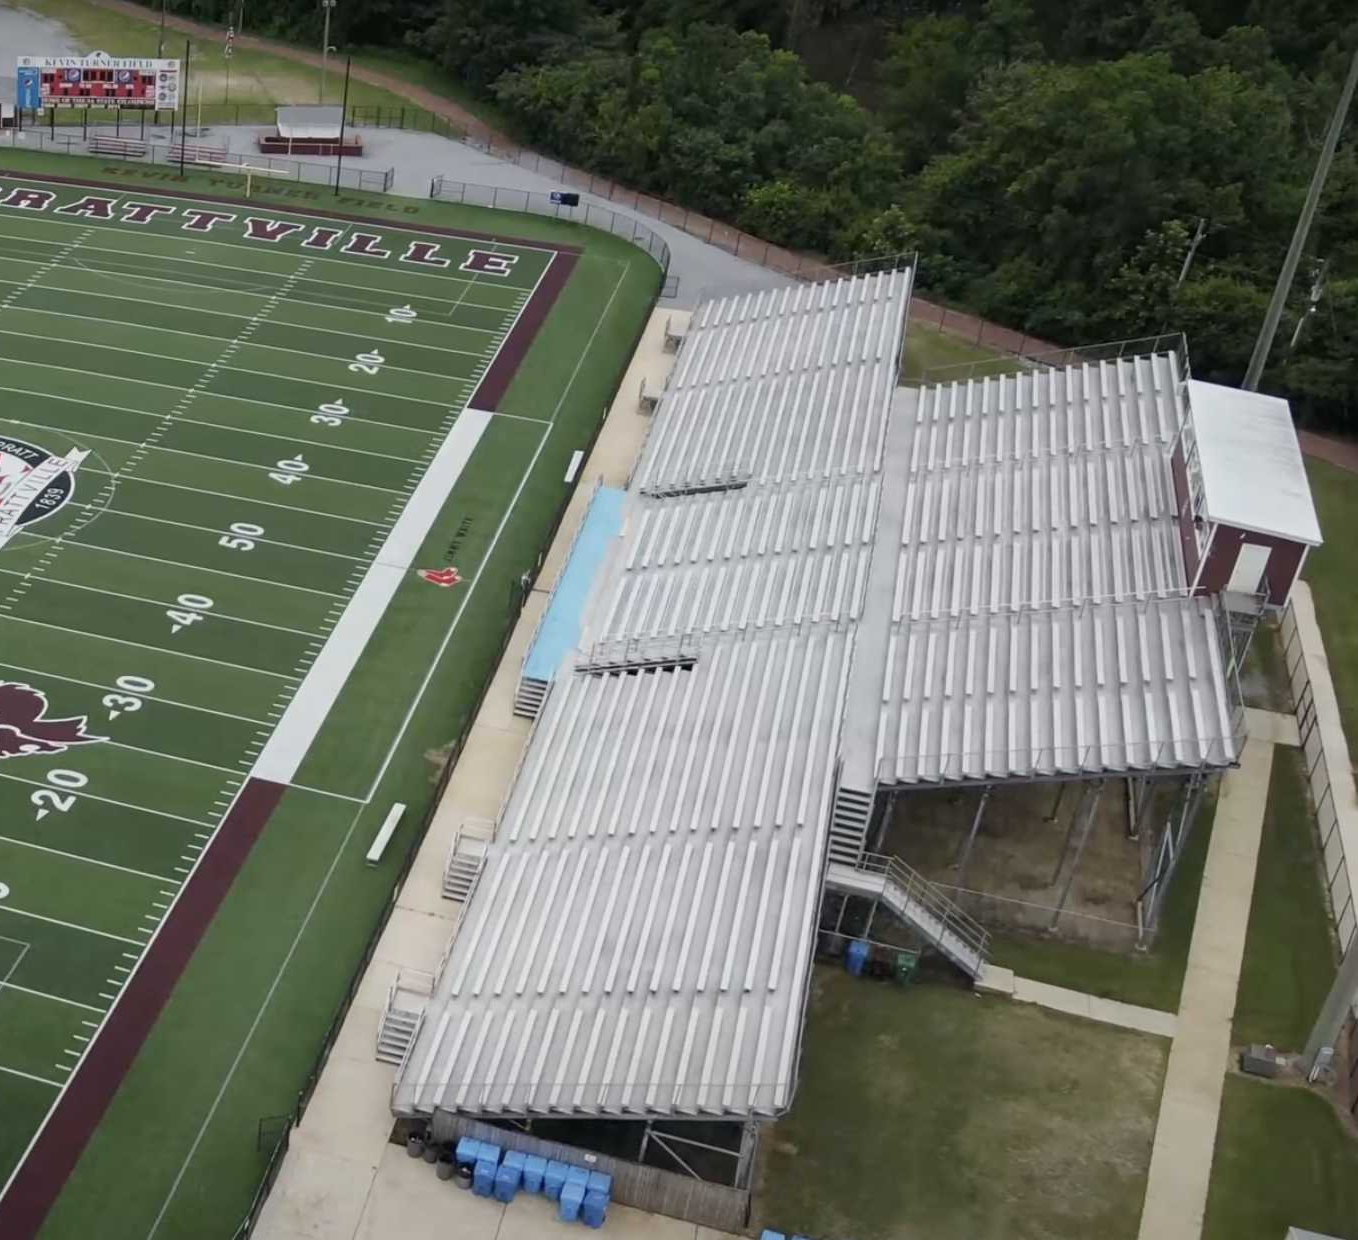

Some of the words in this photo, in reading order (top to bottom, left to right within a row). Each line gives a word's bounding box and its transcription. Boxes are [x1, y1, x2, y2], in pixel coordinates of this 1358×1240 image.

[45, 58, 76, 66] KEVIN
[80, 59, 120, 67] TURNER
[123, 59, 153, 68] FIELD
[99, 166, 191, 183] KEVIN
[208, 178, 321, 200] TURNER
[336, 196, 421, 214] FIELD
[384, 308, 418, 324] 10
[348, 353, 385, 375] 20
[310, 404, 350, 427] 30
[268, 459, 310, 485] 40
[35, 487, 65, 510] 1839
[218, 522, 265, 551] 50
[166, 593, 215, 626] 40
[102, 675, 155, 712] 30
[30, 769, 89, 812] 20
